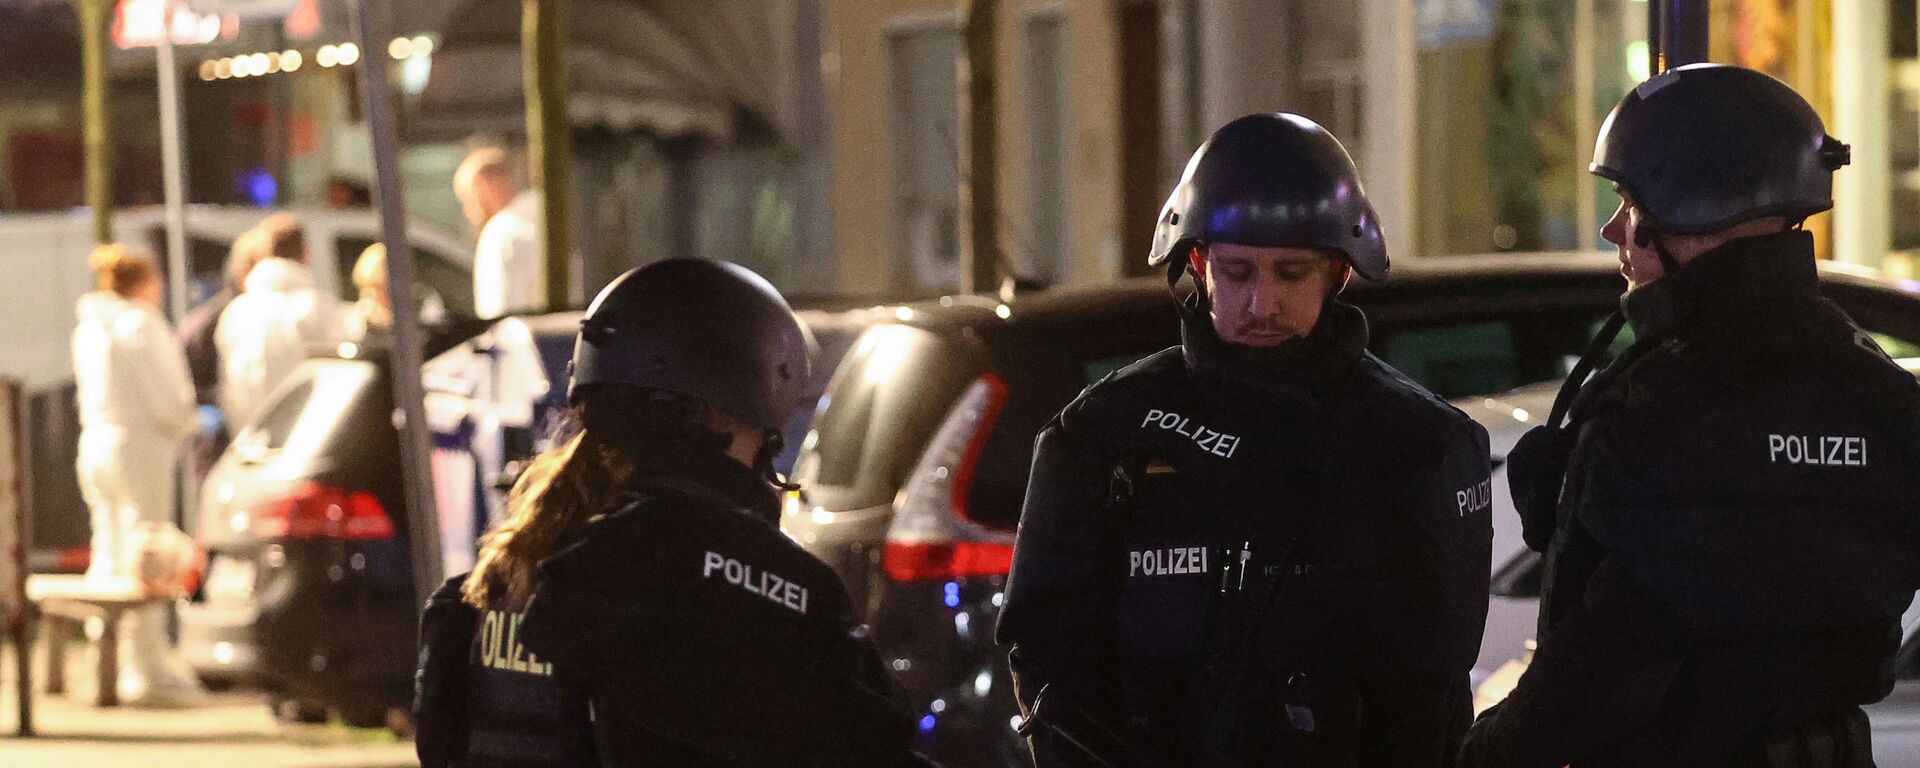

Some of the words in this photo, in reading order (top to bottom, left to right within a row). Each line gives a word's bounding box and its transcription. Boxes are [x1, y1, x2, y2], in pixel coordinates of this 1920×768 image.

[1141, 409, 1241, 459] POLIZEI
[1768, 434, 1867, 466] POLIZEI
[1456, 477, 1490, 517] POLIZ
[1129, 546, 1208, 577] POLIZEI
[703, 551, 808, 614] POLIZEI
